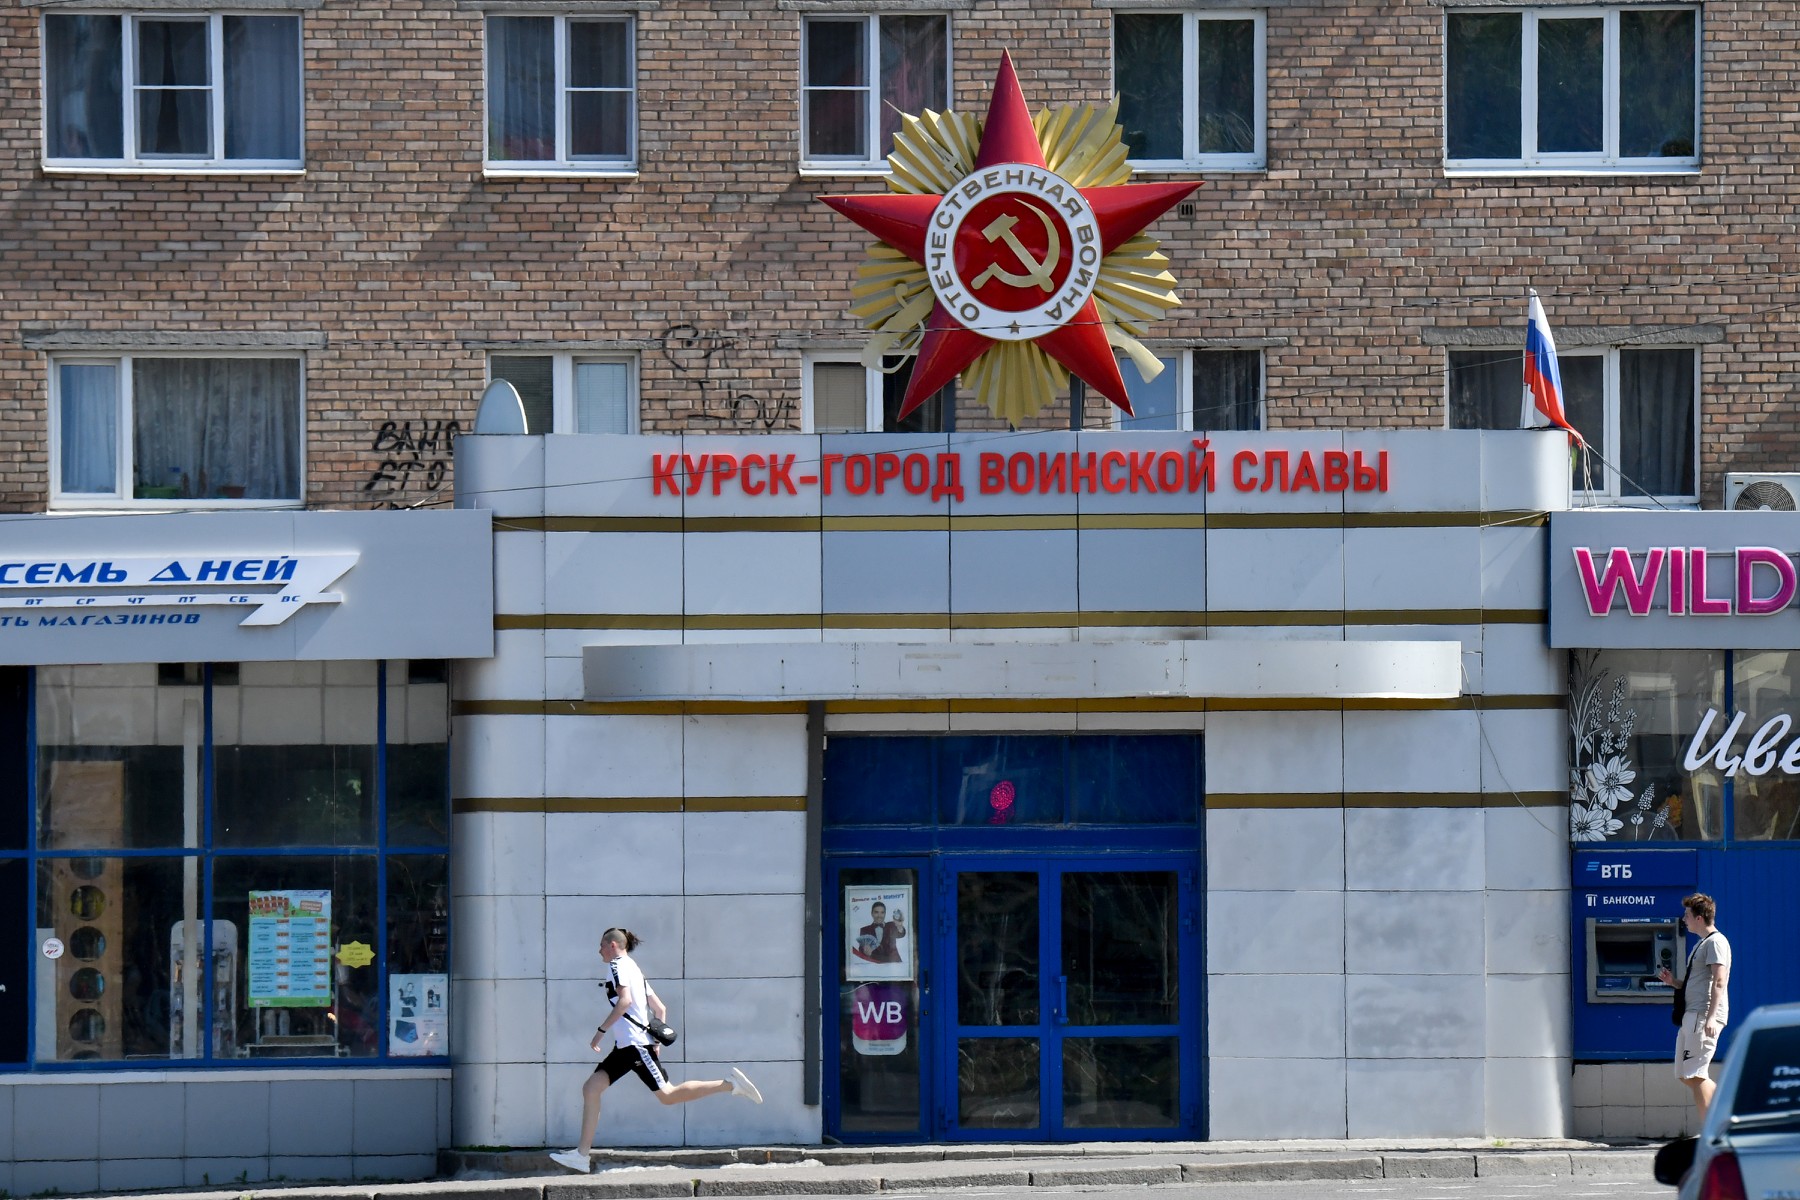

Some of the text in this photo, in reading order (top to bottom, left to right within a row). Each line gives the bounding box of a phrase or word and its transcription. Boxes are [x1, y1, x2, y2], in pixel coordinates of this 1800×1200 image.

[931, 169, 1084, 322] ОТЕЧЕСТВЕННАЯ
[652, 439, 1388, 502] КУРСК-ГОРОД ВОИНСКОЙ СЛАВЫ
[0, 555, 298, 584] СЕМЬ ДНЕЙ
[1572, 546, 1798, 617] WILD
[229, 595, 249, 603] СБ
[281, 595, 300, 603] ВС
[38, 613, 201, 627] МАГАЗИНОВ
[1601, 864, 1633, 879] ВТБ
[1603, 896, 1656, 905] БАНКОМАТ
[857, 1001, 903, 1024] WB
